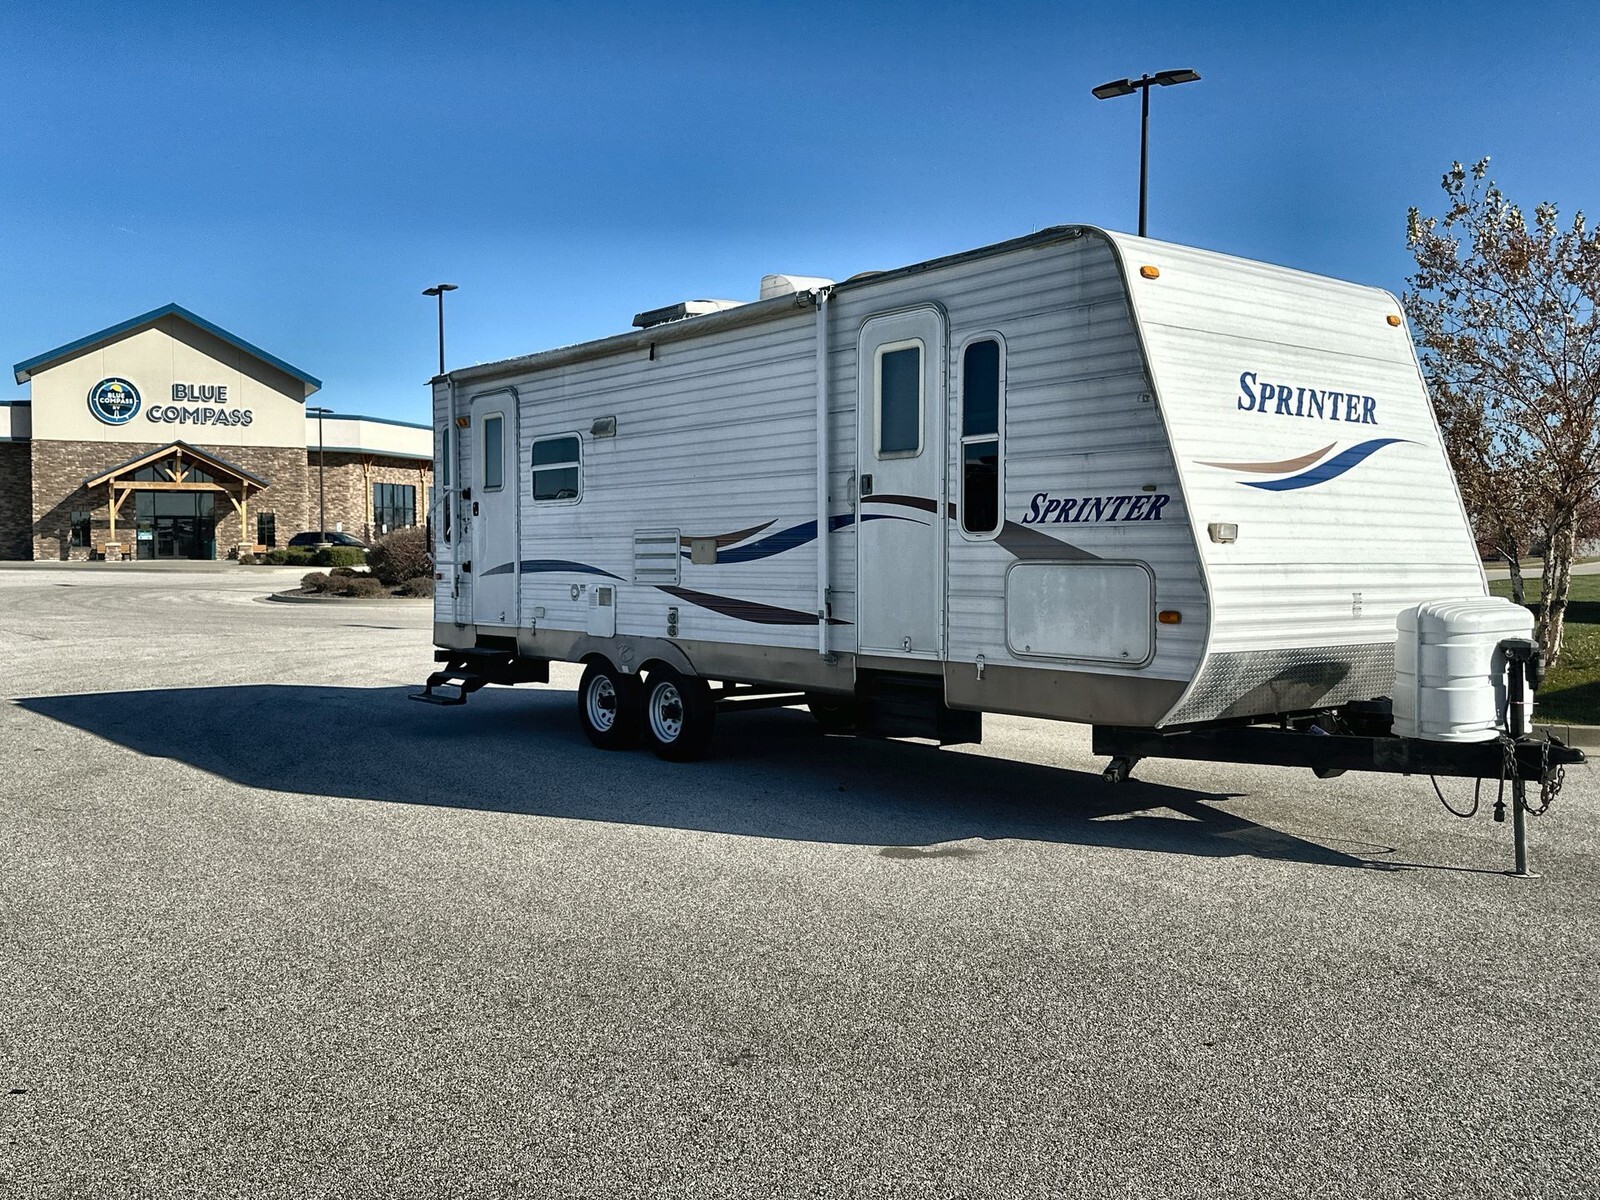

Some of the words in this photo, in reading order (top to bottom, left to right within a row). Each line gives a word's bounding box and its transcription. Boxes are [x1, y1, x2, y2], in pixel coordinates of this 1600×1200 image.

[99, 397, 134, 405] COMPASS
[172, 383, 228, 403] BLUE
[146, 405, 253, 427] COMPASS
